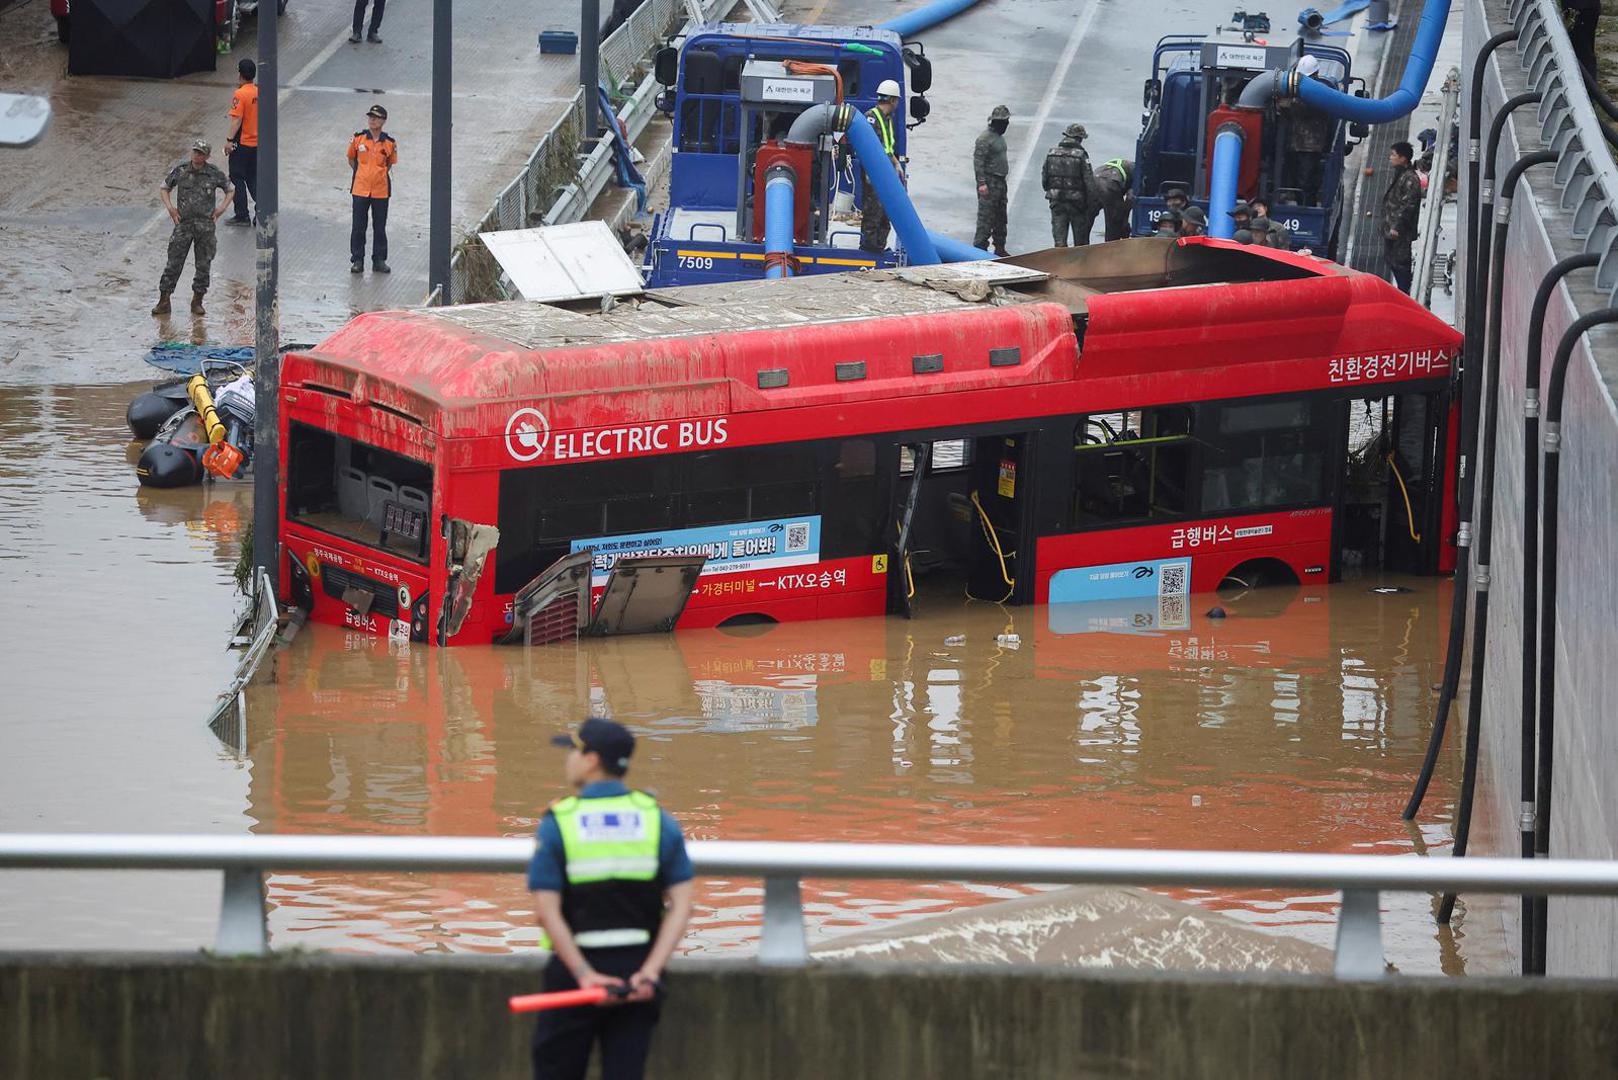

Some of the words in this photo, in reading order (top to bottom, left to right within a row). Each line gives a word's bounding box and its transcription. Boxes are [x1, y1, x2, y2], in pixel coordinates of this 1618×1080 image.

[677, 256, 713, 270] 7509
[1328, 349, 1449, 382] 친환경전기버스
[554, 423, 669, 460] ELECTRIC
[679, 418, 728, 448] BUS
[732, 535, 777, 558] 물어봐!
[1171, 526, 1233, 549] 급행버스
[702, 578, 755, 597] 가경터미널
[777, 568, 847, 591] KTX오송역
